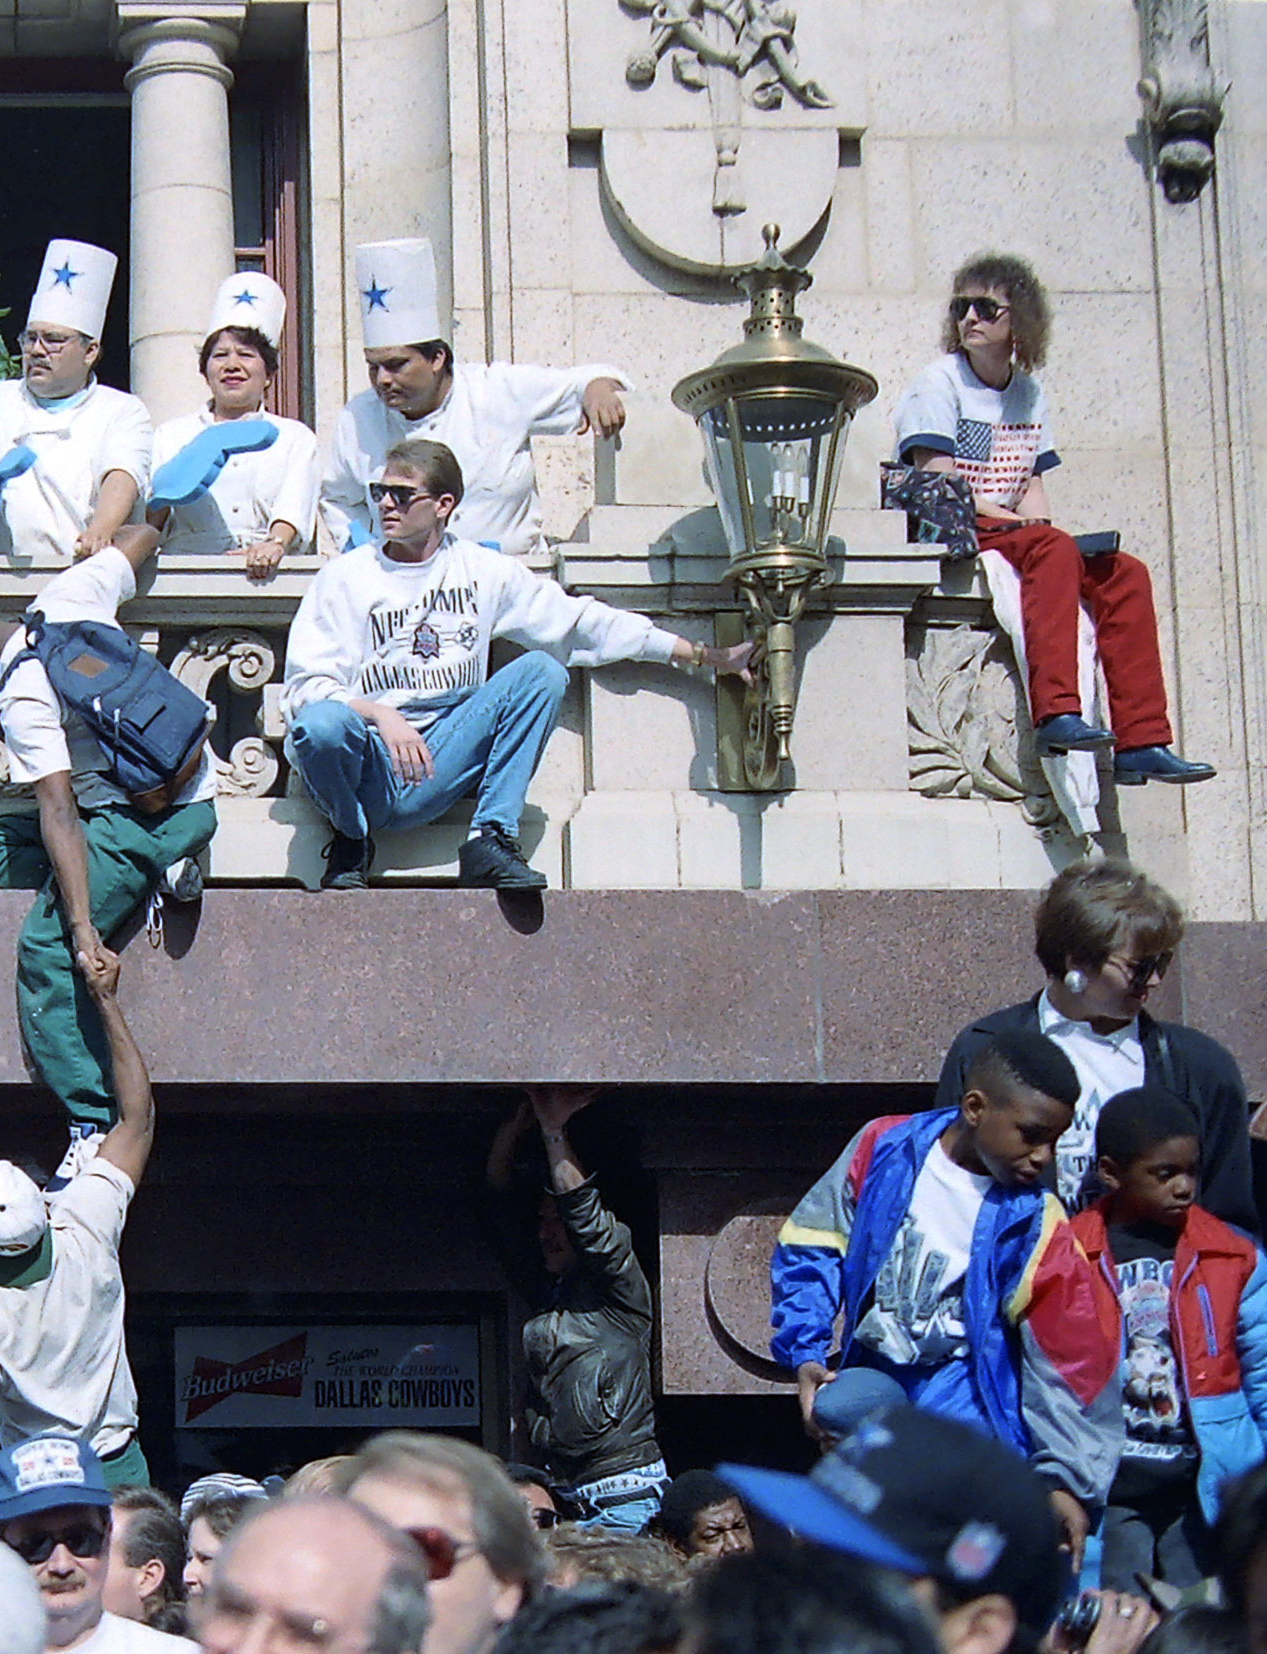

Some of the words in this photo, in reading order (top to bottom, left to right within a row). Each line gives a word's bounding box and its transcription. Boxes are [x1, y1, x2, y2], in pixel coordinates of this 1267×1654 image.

[362, 662, 421, 694] DALLAS
[181, 1356, 315, 1403] Budweiser
[314, 1379, 383, 1409] DALLAS
[388, 1379, 475, 1409] COWBOYS
